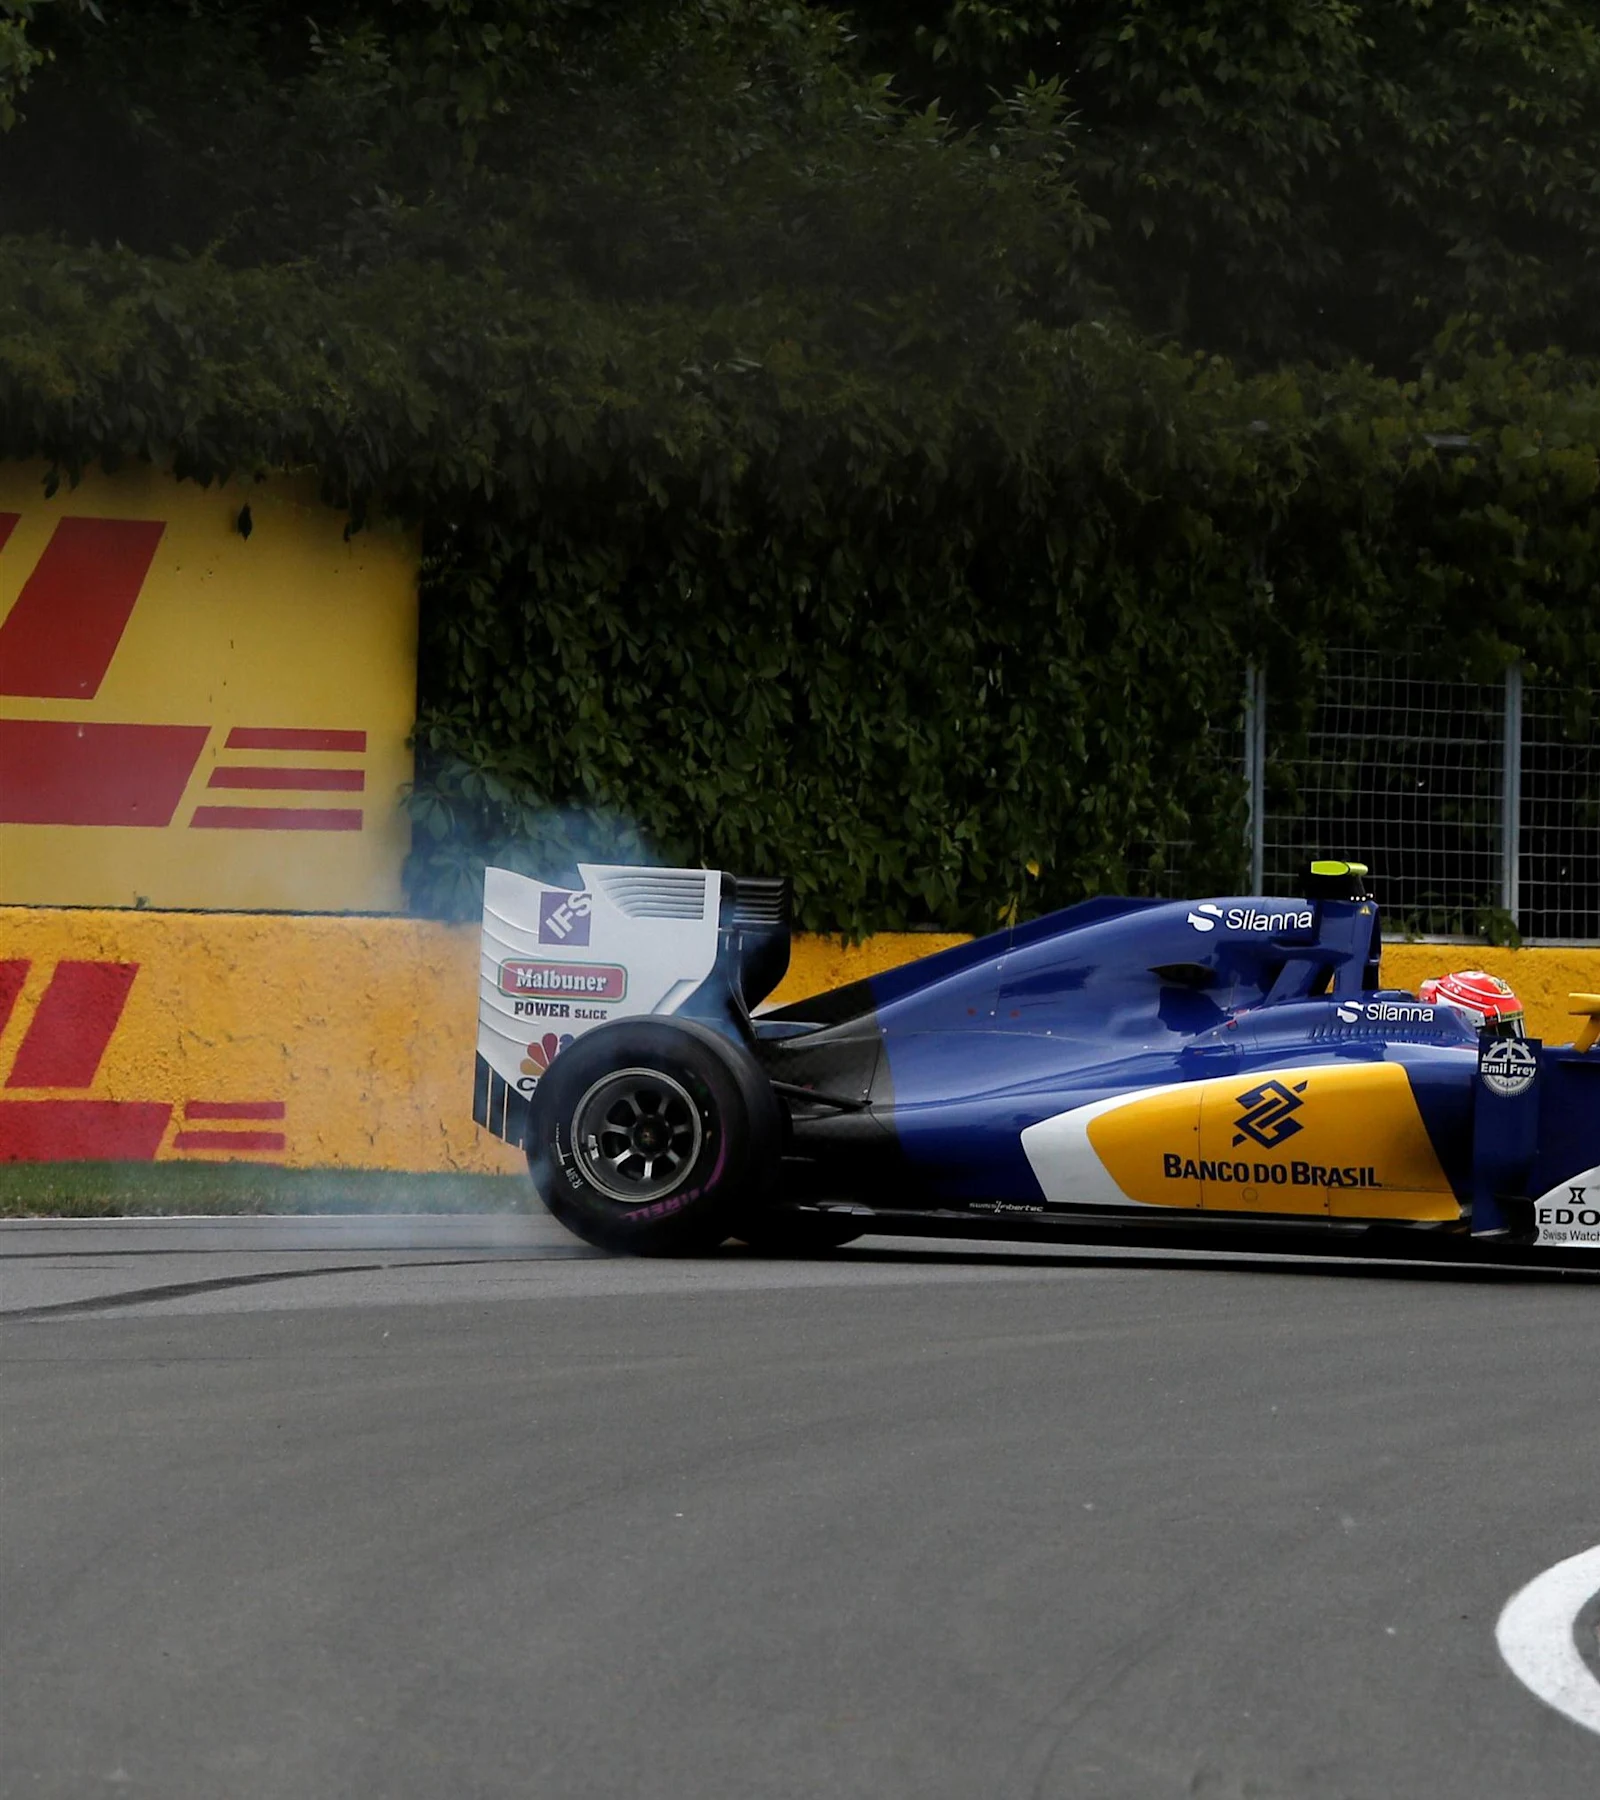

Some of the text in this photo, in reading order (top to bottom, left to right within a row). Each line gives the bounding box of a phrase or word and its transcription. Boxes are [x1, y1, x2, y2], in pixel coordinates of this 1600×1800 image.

[545, 892, 592, 939] IFS
[1225, 908, 1313, 931] Silanna
[515, 967, 607, 992] Malbuner
[514, 1001, 608, 1020] POWER SLICE
[1366, 1003, 1434, 1023] Silanna
[1480, 1062, 1537, 1078] Emil Frey
[1163, 1153, 1383, 1188] BANCO DO BRASIL
[1542, 1229, 1567, 1240] Swiss
